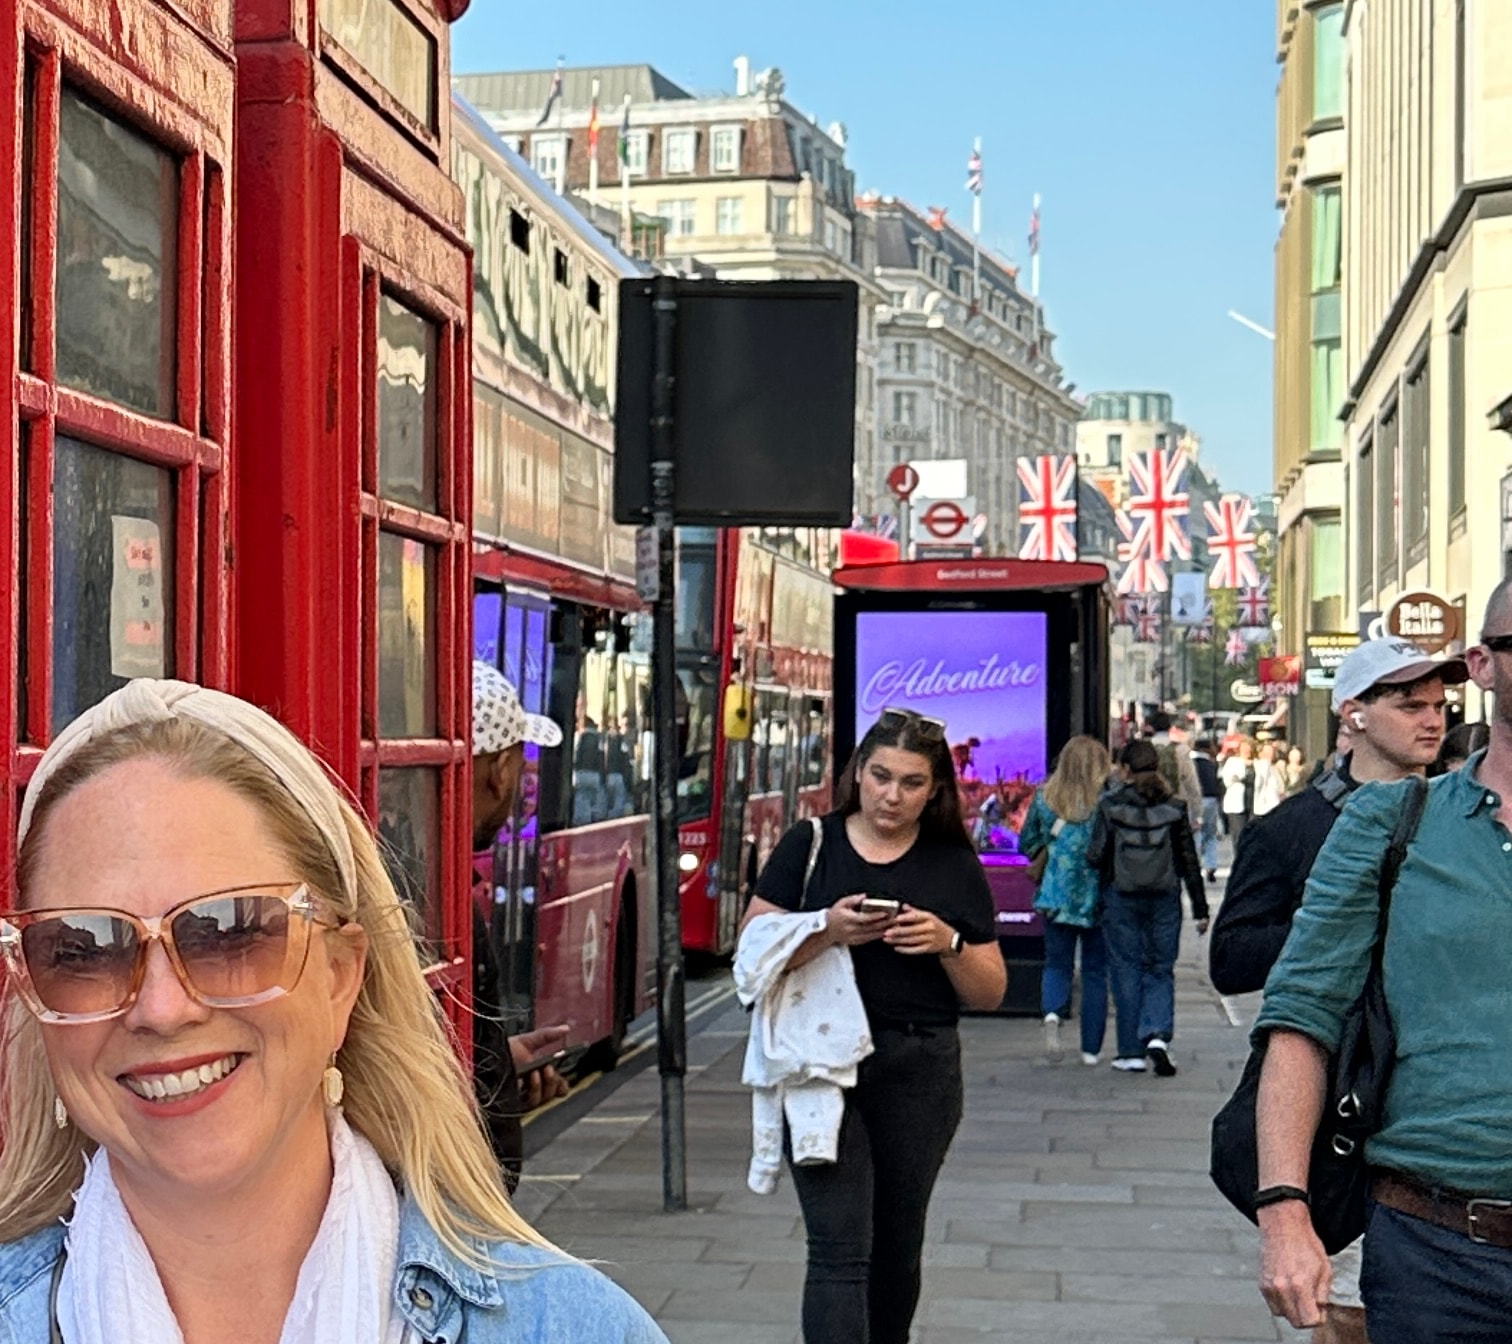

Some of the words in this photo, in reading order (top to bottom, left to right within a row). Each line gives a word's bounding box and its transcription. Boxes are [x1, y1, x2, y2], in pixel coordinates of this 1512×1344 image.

[896, 467, 913, 493] J
[978, 568, 1009, 579] Street
[1398, 601, 1444, 619] Bella
[1398, 618, 1445, 636] Italia
[861, 652, 1041, 714] Adventure
